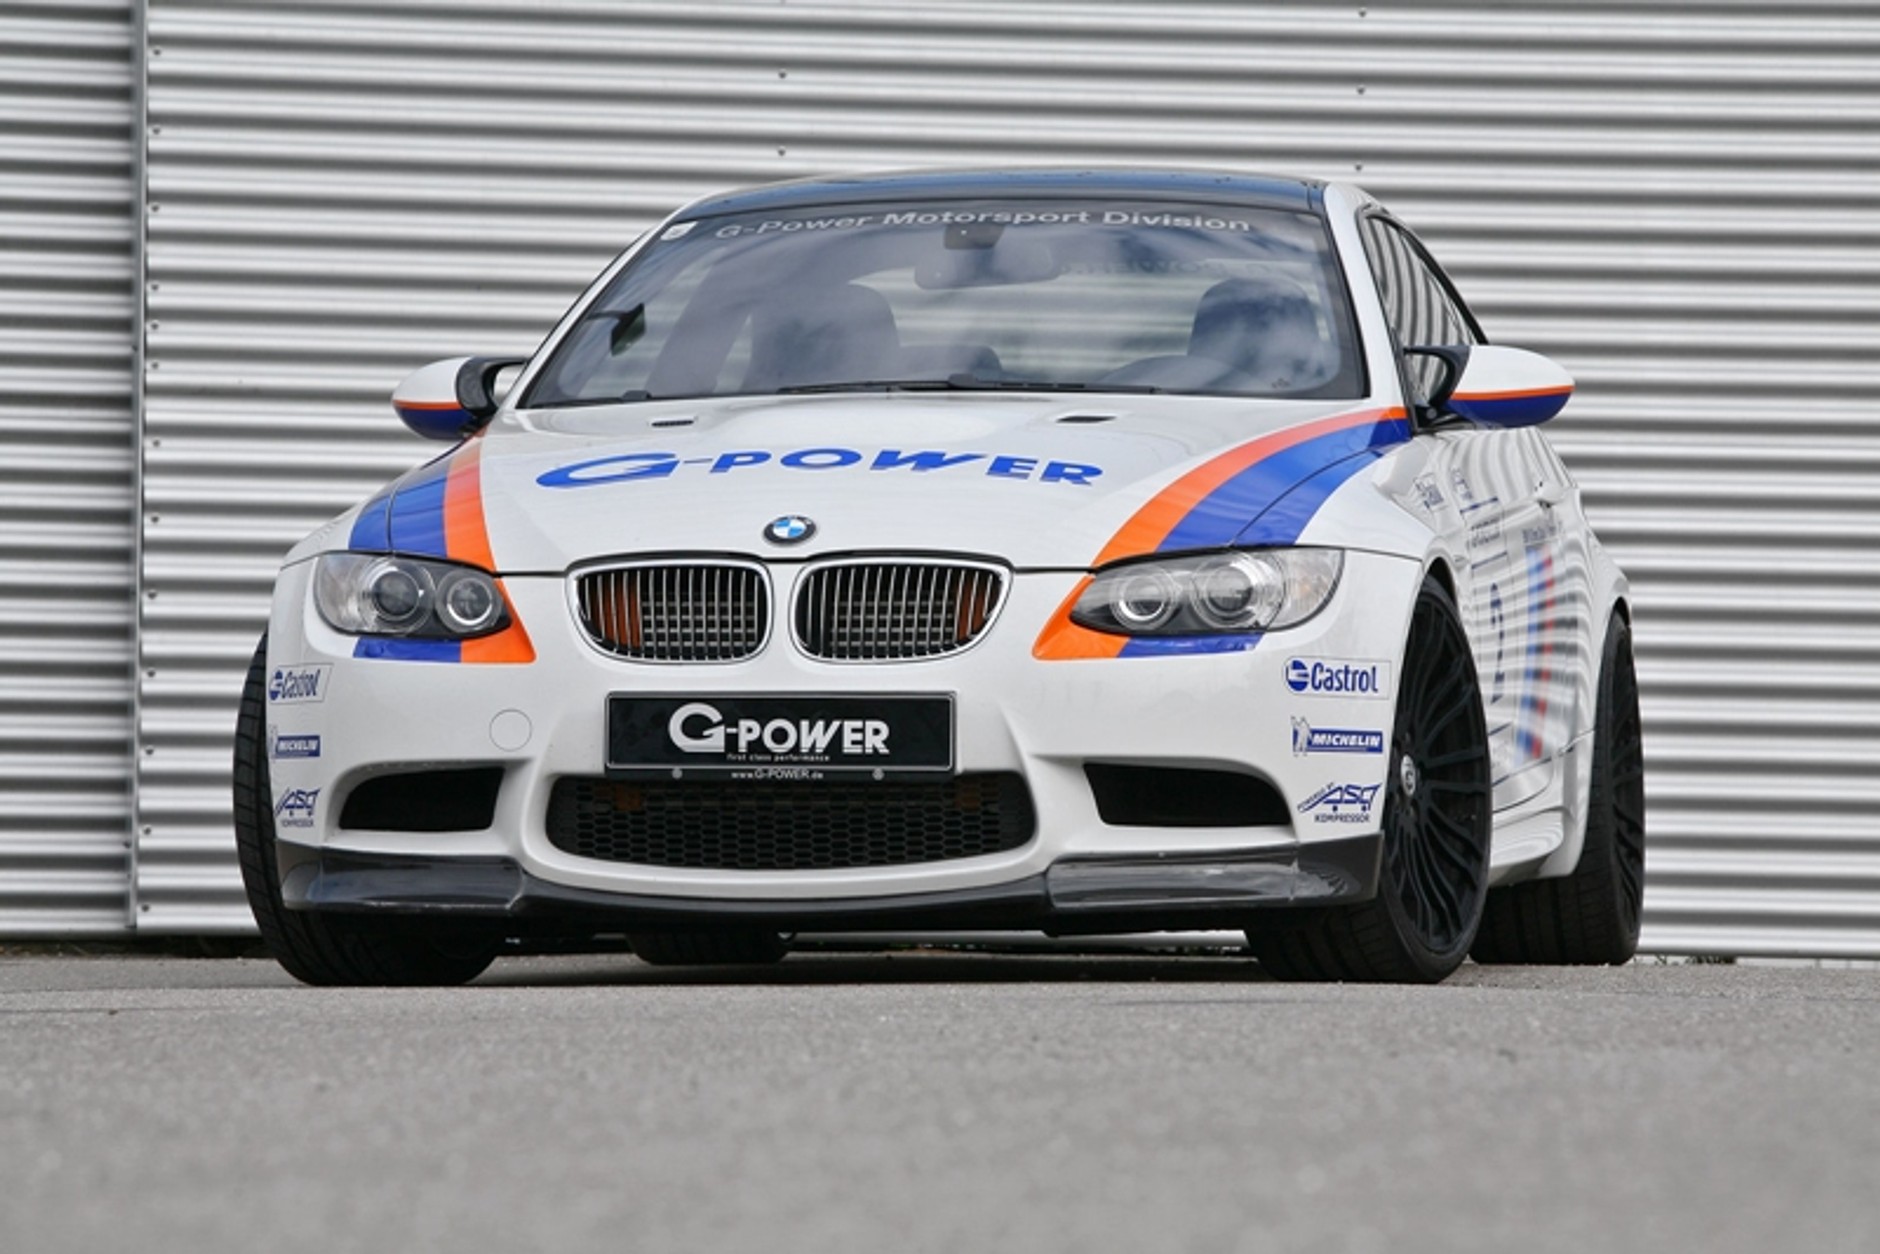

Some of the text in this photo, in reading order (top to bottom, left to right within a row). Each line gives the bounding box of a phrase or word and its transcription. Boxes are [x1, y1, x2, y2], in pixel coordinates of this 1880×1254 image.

[715, 211, 1251, 238] G-Power Motorsport Division
[535, 447, 1104, 487] G-POWER
[1311, 661, 1379, 693] Castrol
[668, 702, 890, 753] G-POWER
[1312, 733, 1381, 747] MICHELIN
